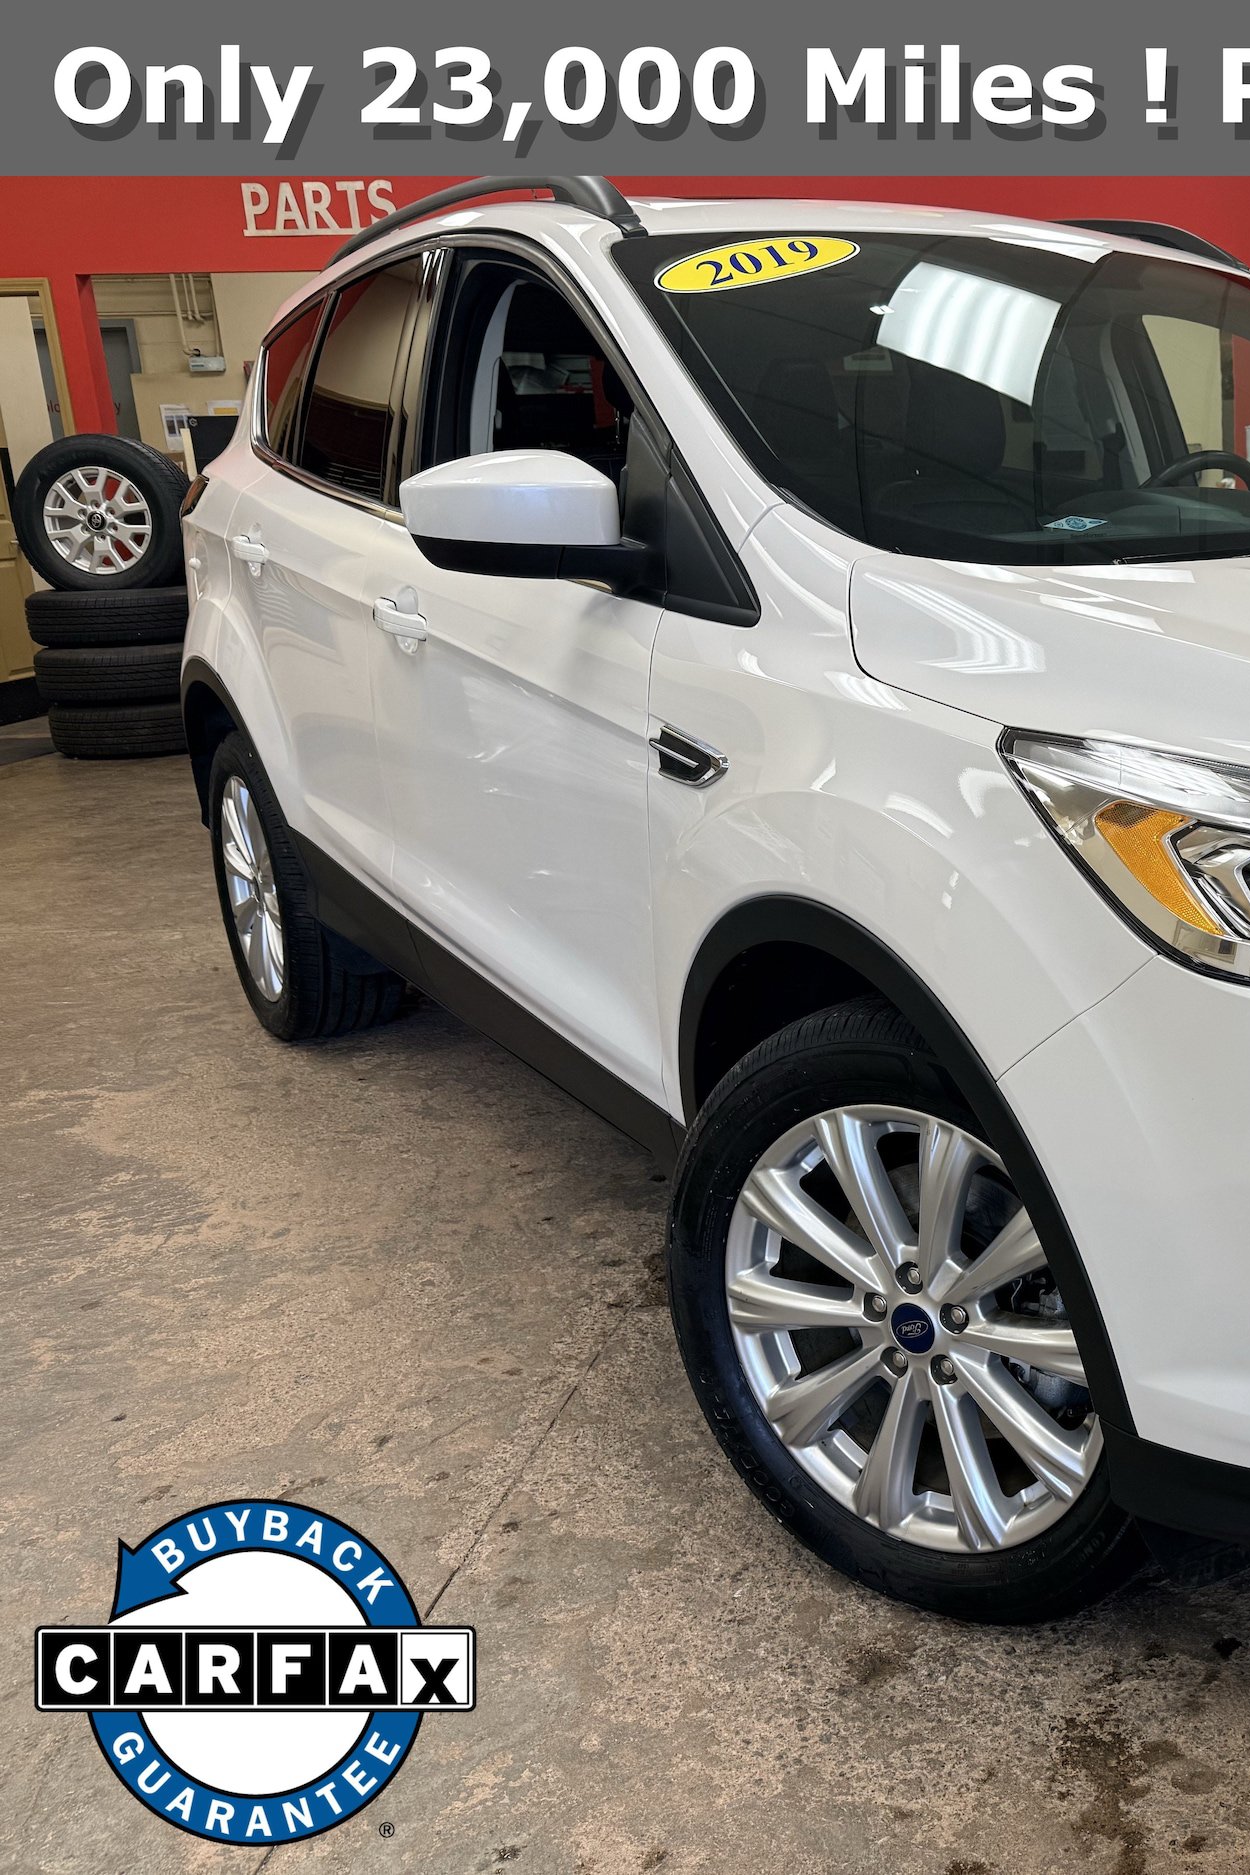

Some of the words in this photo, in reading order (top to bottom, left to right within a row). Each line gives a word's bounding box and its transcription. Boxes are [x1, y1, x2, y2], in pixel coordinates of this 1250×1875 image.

[241, 180, 397, 230] PARTS
[696, 239, 819, 286] 2019
[902, 1323, 922, 1336] Ford
